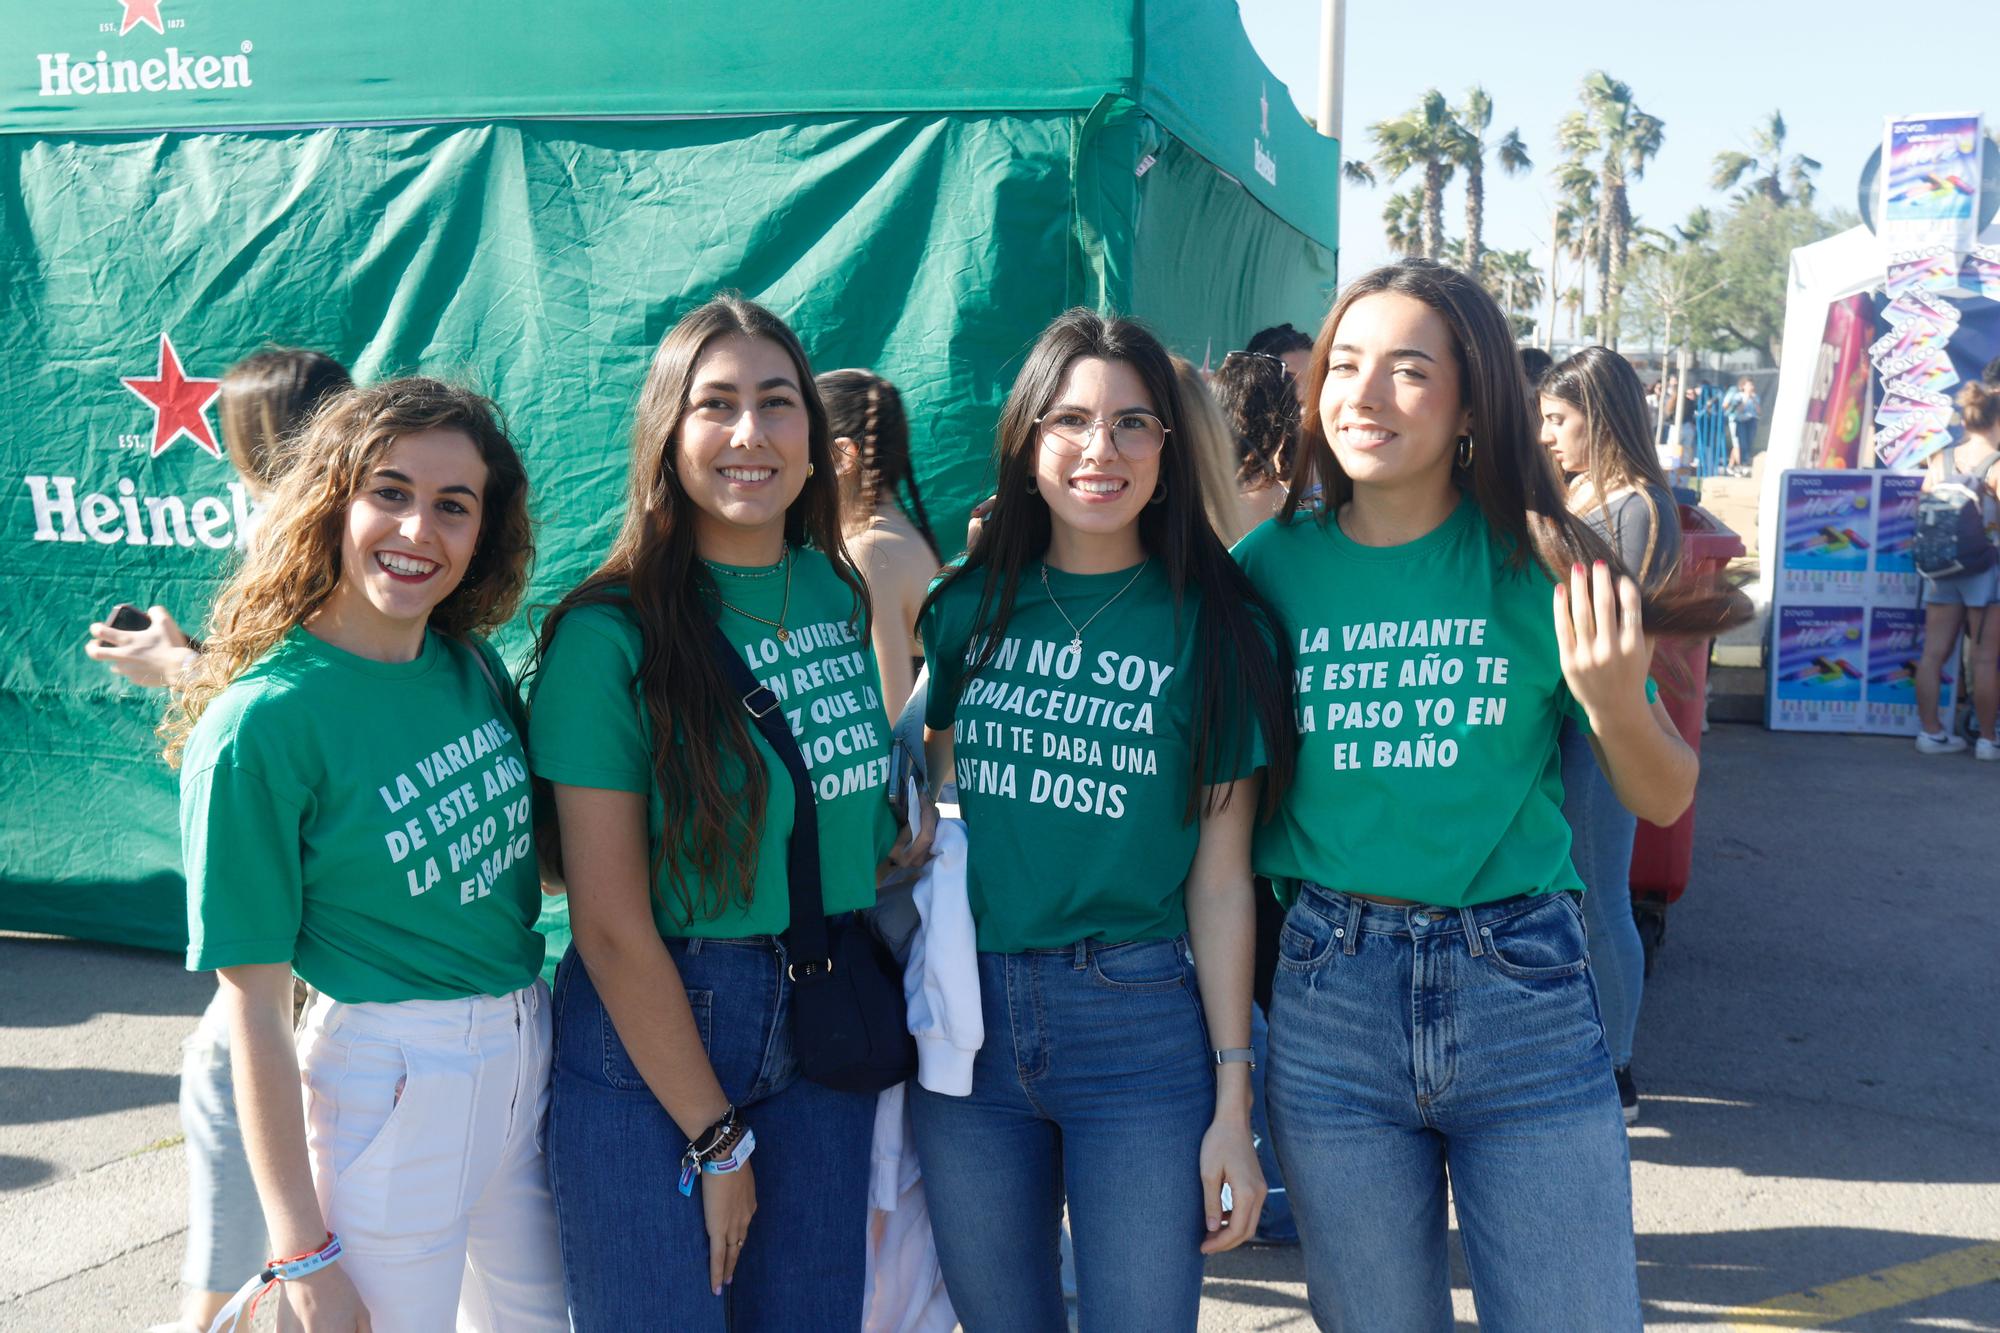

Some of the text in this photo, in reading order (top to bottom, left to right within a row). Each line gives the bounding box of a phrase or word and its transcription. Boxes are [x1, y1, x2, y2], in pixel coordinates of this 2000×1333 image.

[99, 23, 117, 33] EST.
[118, 434, 146, 449] EST.
[744, 638, 780, 671] LO
[1299, 618, 1487, 655] LA VARIANTE
[1026, 639, 1083, 680] NO
[1091, 650, 1175, 698] SOY
[1323, 660, 1389, 691] ESTE
[1398, 652, 1464, 688] AÑO
[1476, 656, 1509, 685] TE
[810, 690, 862, 725] QUE
[1294, 696, 1507, 735] LA PASO YO EN
[967, 718, 978, 745] A
[985, 721, 1003, 748] TI
[1010, 726, 1034, 754] TE
[1042, 732, 1103, 767] DABA
[1111, 744, 1158, 776] UNA
[1333, 732, 1459, 771] EL BAÑO
[379, 773, 421, 814] LA
[384, 755, 527, 864] DE ESTE AÑO
[1029, 768, 1128, 819] DOSIS
[406, 795, 530, 897] LA PASO YO
